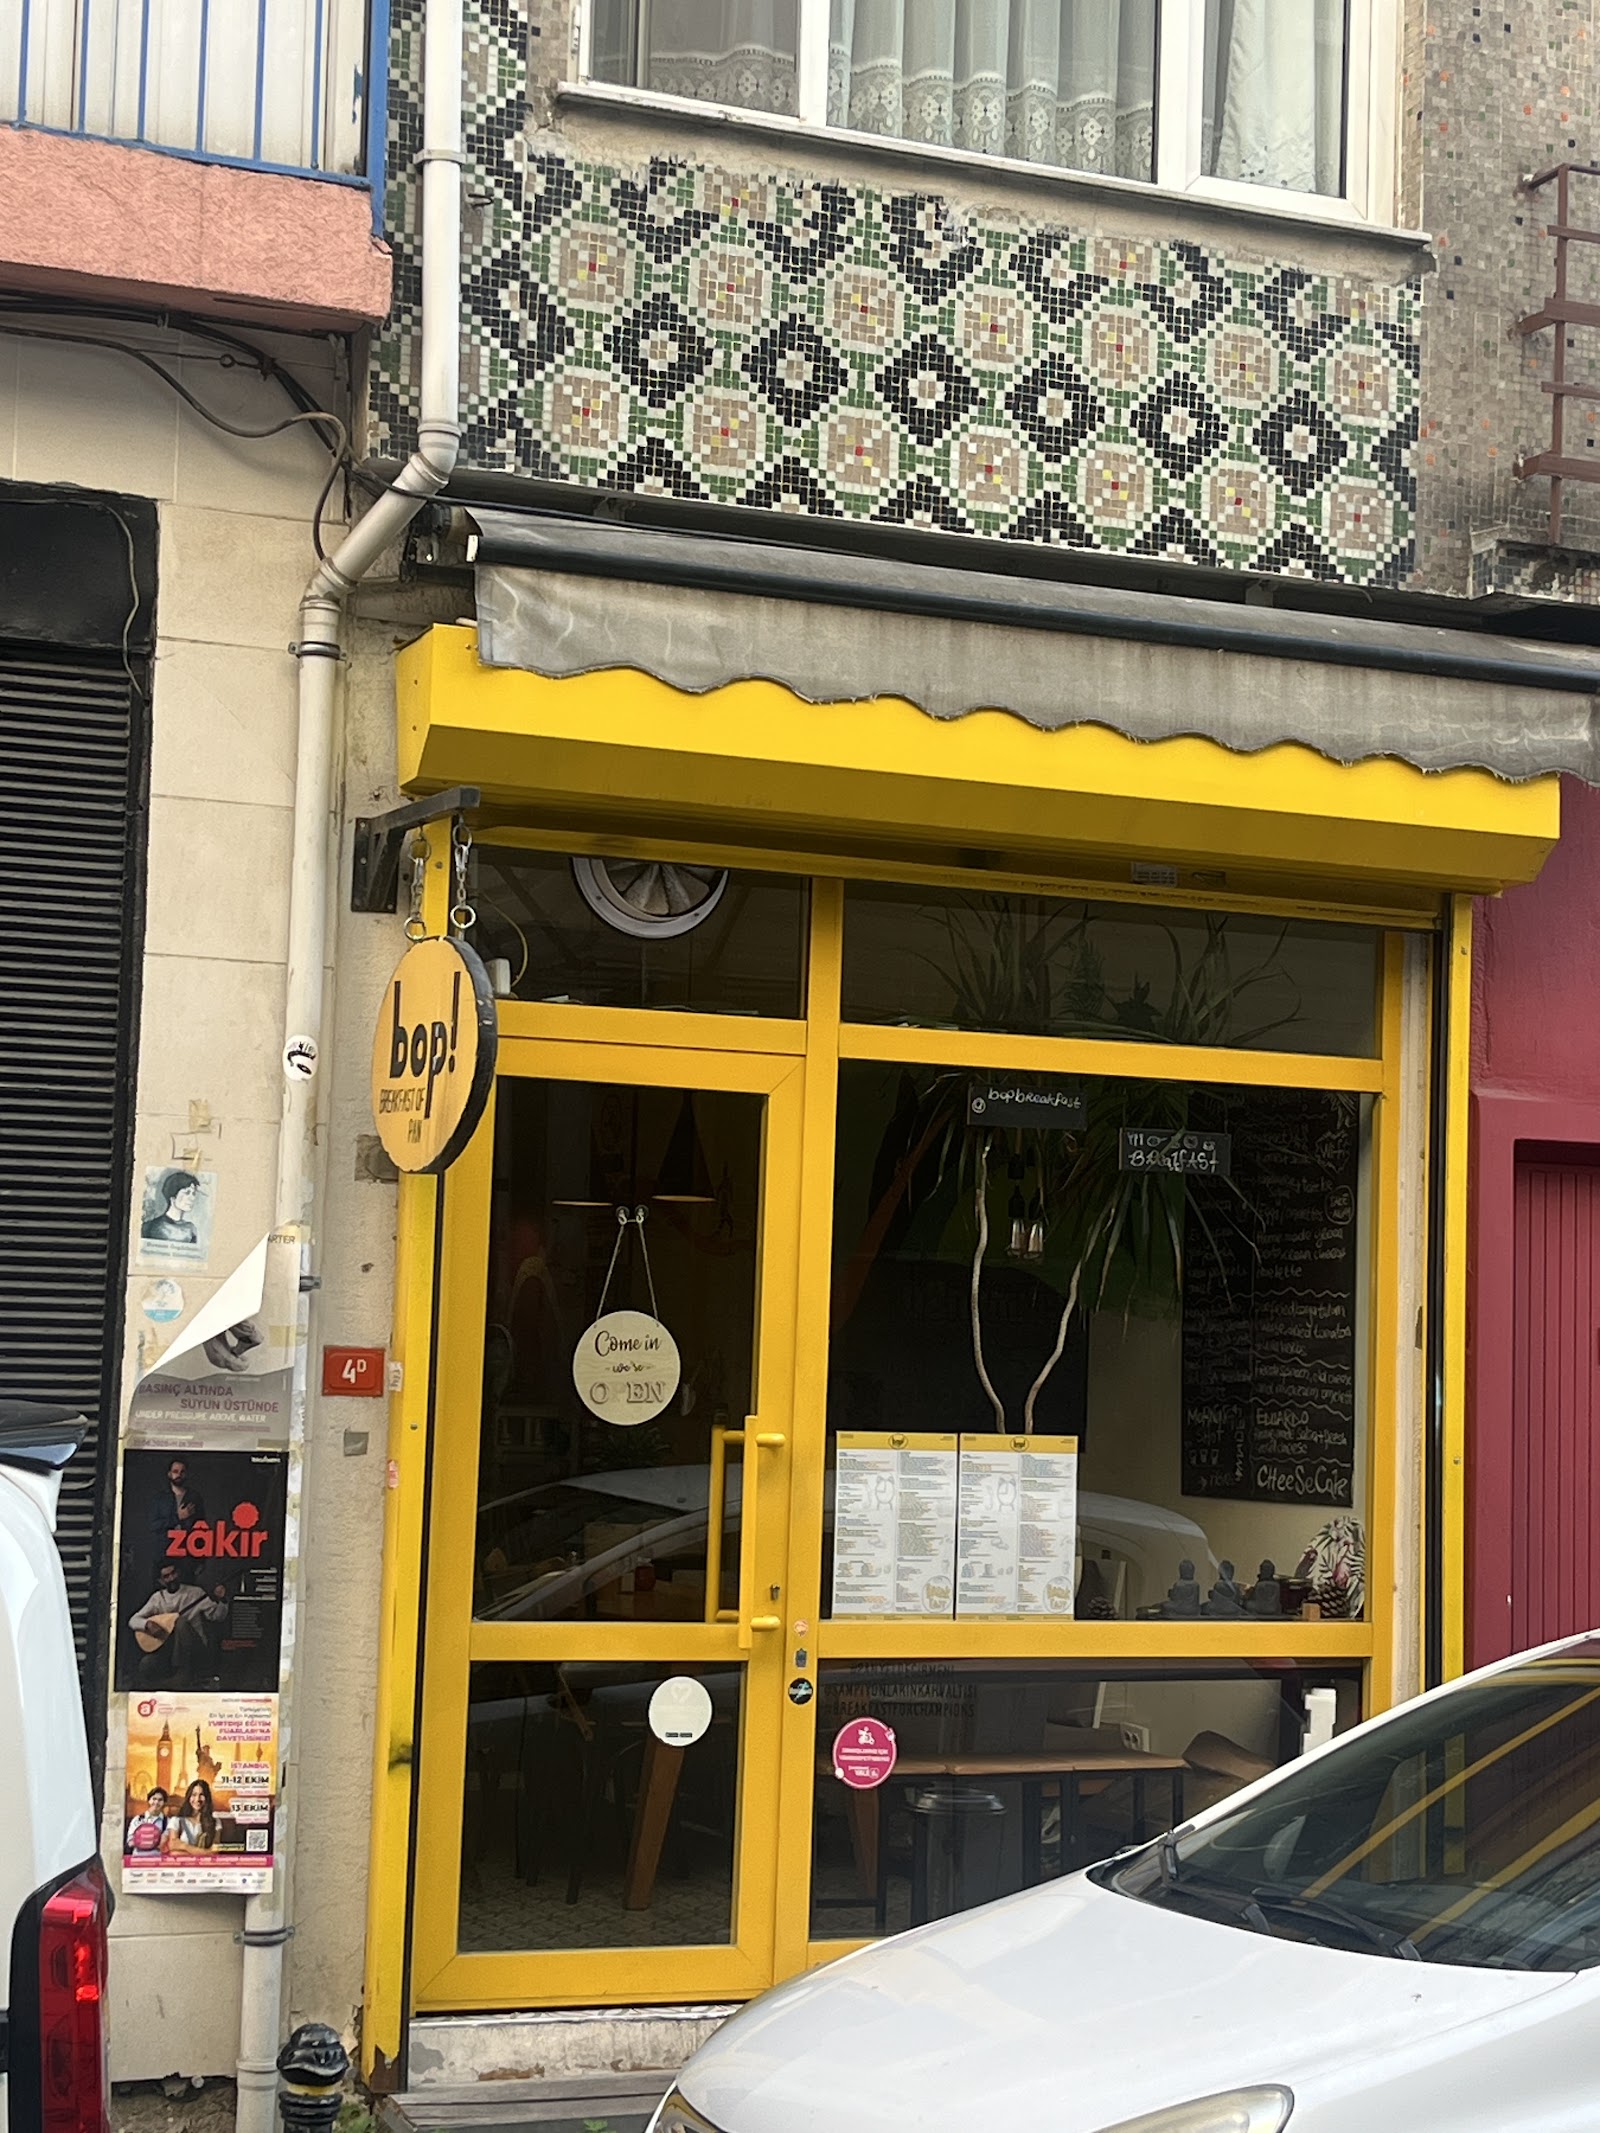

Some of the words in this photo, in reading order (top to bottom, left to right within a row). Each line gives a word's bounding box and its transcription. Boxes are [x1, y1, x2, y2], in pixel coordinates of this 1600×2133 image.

[389, 971, 462, 1120] bop!
[595, 1330, 642, 1357] Come
[644, 1334, 661, 1352] in
[138, 1383, 181, 1397] BASINÇ
[184, 1385, 234, 1397] ALTINDA
[224, 1399, 280, 1413] ÜSTÜNDE
[209, 1413, 237, 1422] ABOVE
[166, 1502, 269, 1558] zâkir
